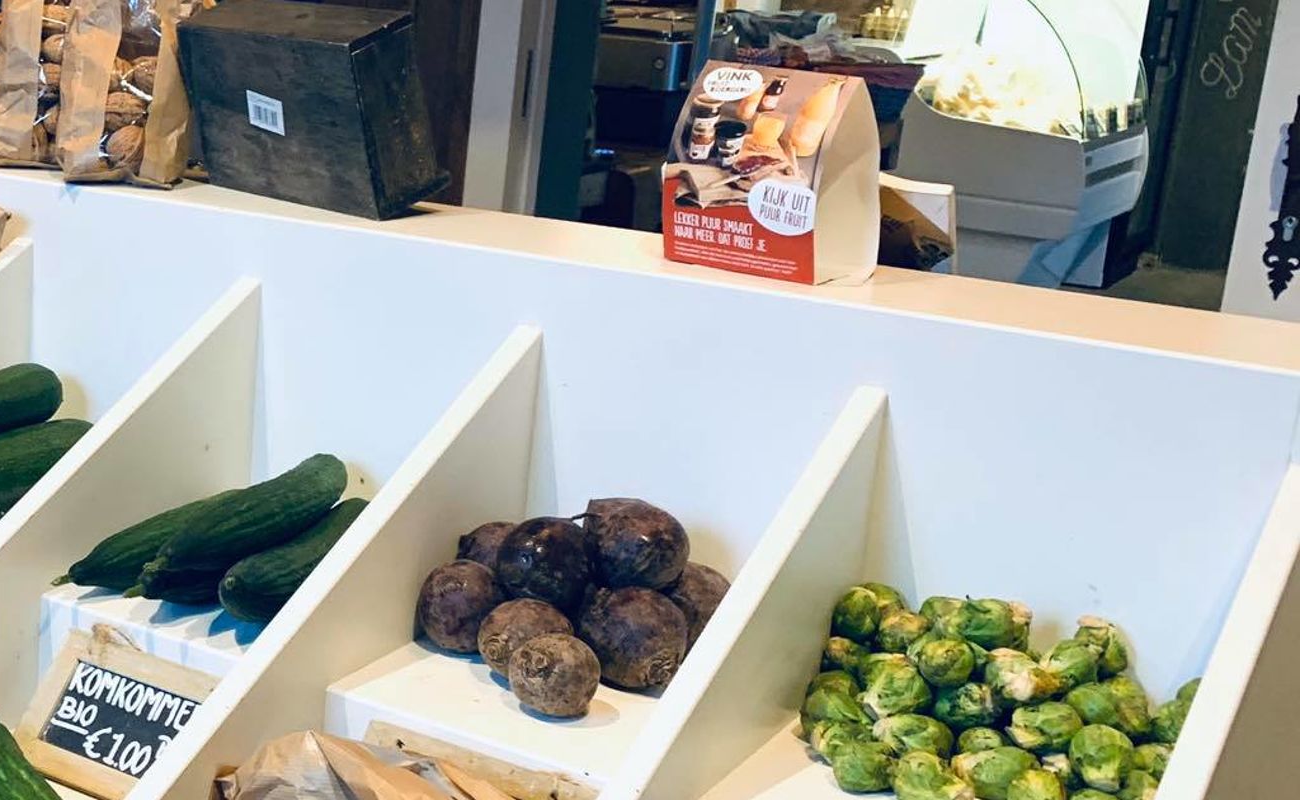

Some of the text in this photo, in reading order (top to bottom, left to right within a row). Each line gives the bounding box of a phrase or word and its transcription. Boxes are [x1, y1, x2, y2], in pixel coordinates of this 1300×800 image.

[717, 71, 753, 81] VINK
[791, 193, 811, 214] UIT
[69, 662, 201, 731] KOMKOMME
[57, 696, 99, 726] BIO
